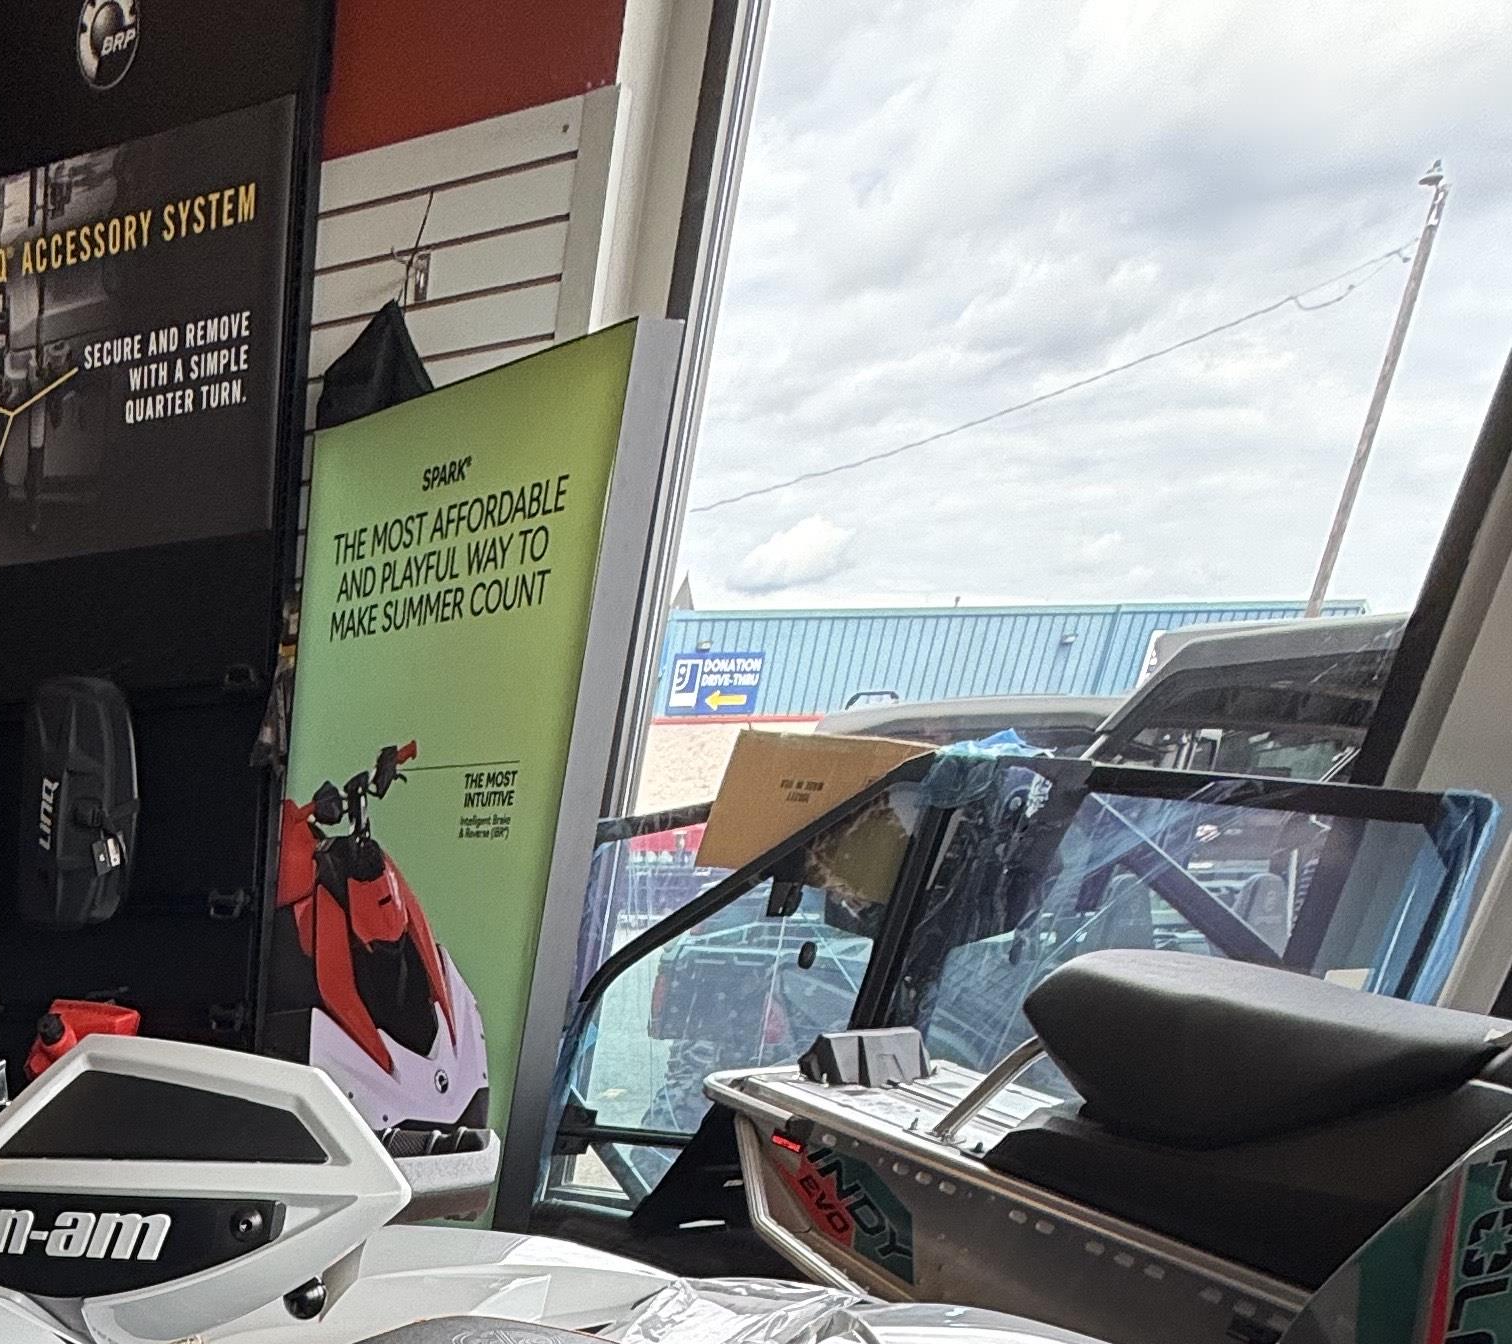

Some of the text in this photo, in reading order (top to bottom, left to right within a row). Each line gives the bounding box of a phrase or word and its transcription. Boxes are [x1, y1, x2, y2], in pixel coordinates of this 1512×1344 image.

[100, 28, 136, 57] BRP
[22, 210, 152, 276] ACCESSORY
[163, 183, 256, 242] SYSTEM
[84, 311, 250, 369] SECURE AND REMOVE
[129, 344, 249, 392] WITH A SIMPLE
[125, 379, 247, 424] QUARTER TURN.
[333, 473, 570, 565] THE MOST AFFORDABLE
[337, 525, 549, 602] AND PLAYFUL WAY TO
[329, 569, 551, 643] MAKE SUMMER COUNT
[701, 673, 759, 687] DRIVE-THRU
[703, 658, 762, 672] DONATION
[464, 790, 515, 808] INTUITIVE
[465, 770, 518, 789] THE MOST
[800, 1176, 849, 1233] EVO
